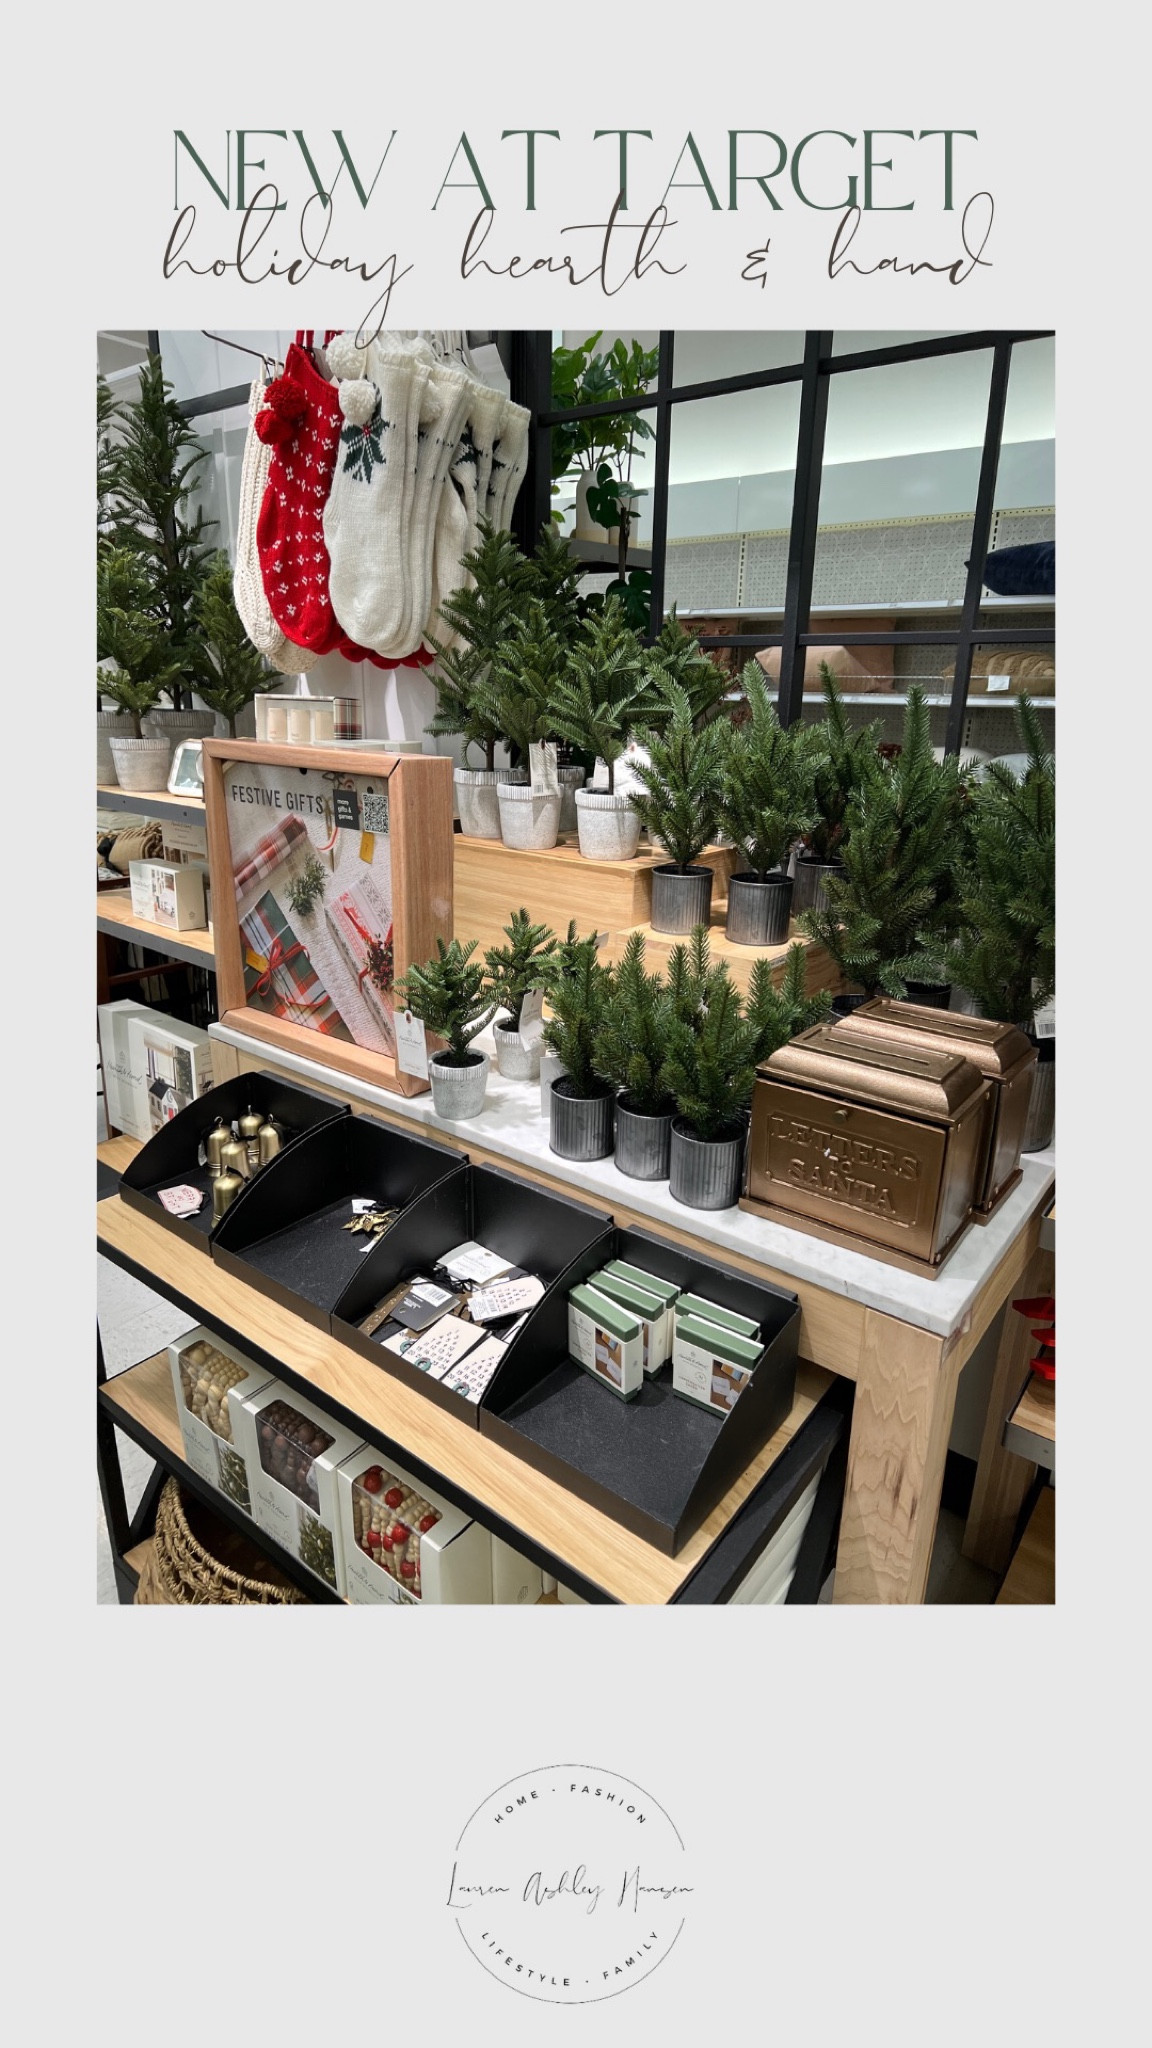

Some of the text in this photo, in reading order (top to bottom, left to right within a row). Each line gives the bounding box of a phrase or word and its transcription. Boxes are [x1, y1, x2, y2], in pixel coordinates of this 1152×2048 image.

[231, 785, 324, 814] FESTIVE GIFTS
[770, 1116, 918, 1181] LETTERS
[828, 1155, 852, 1174] TO
[788, 1158, 897, 1214] SANTA
